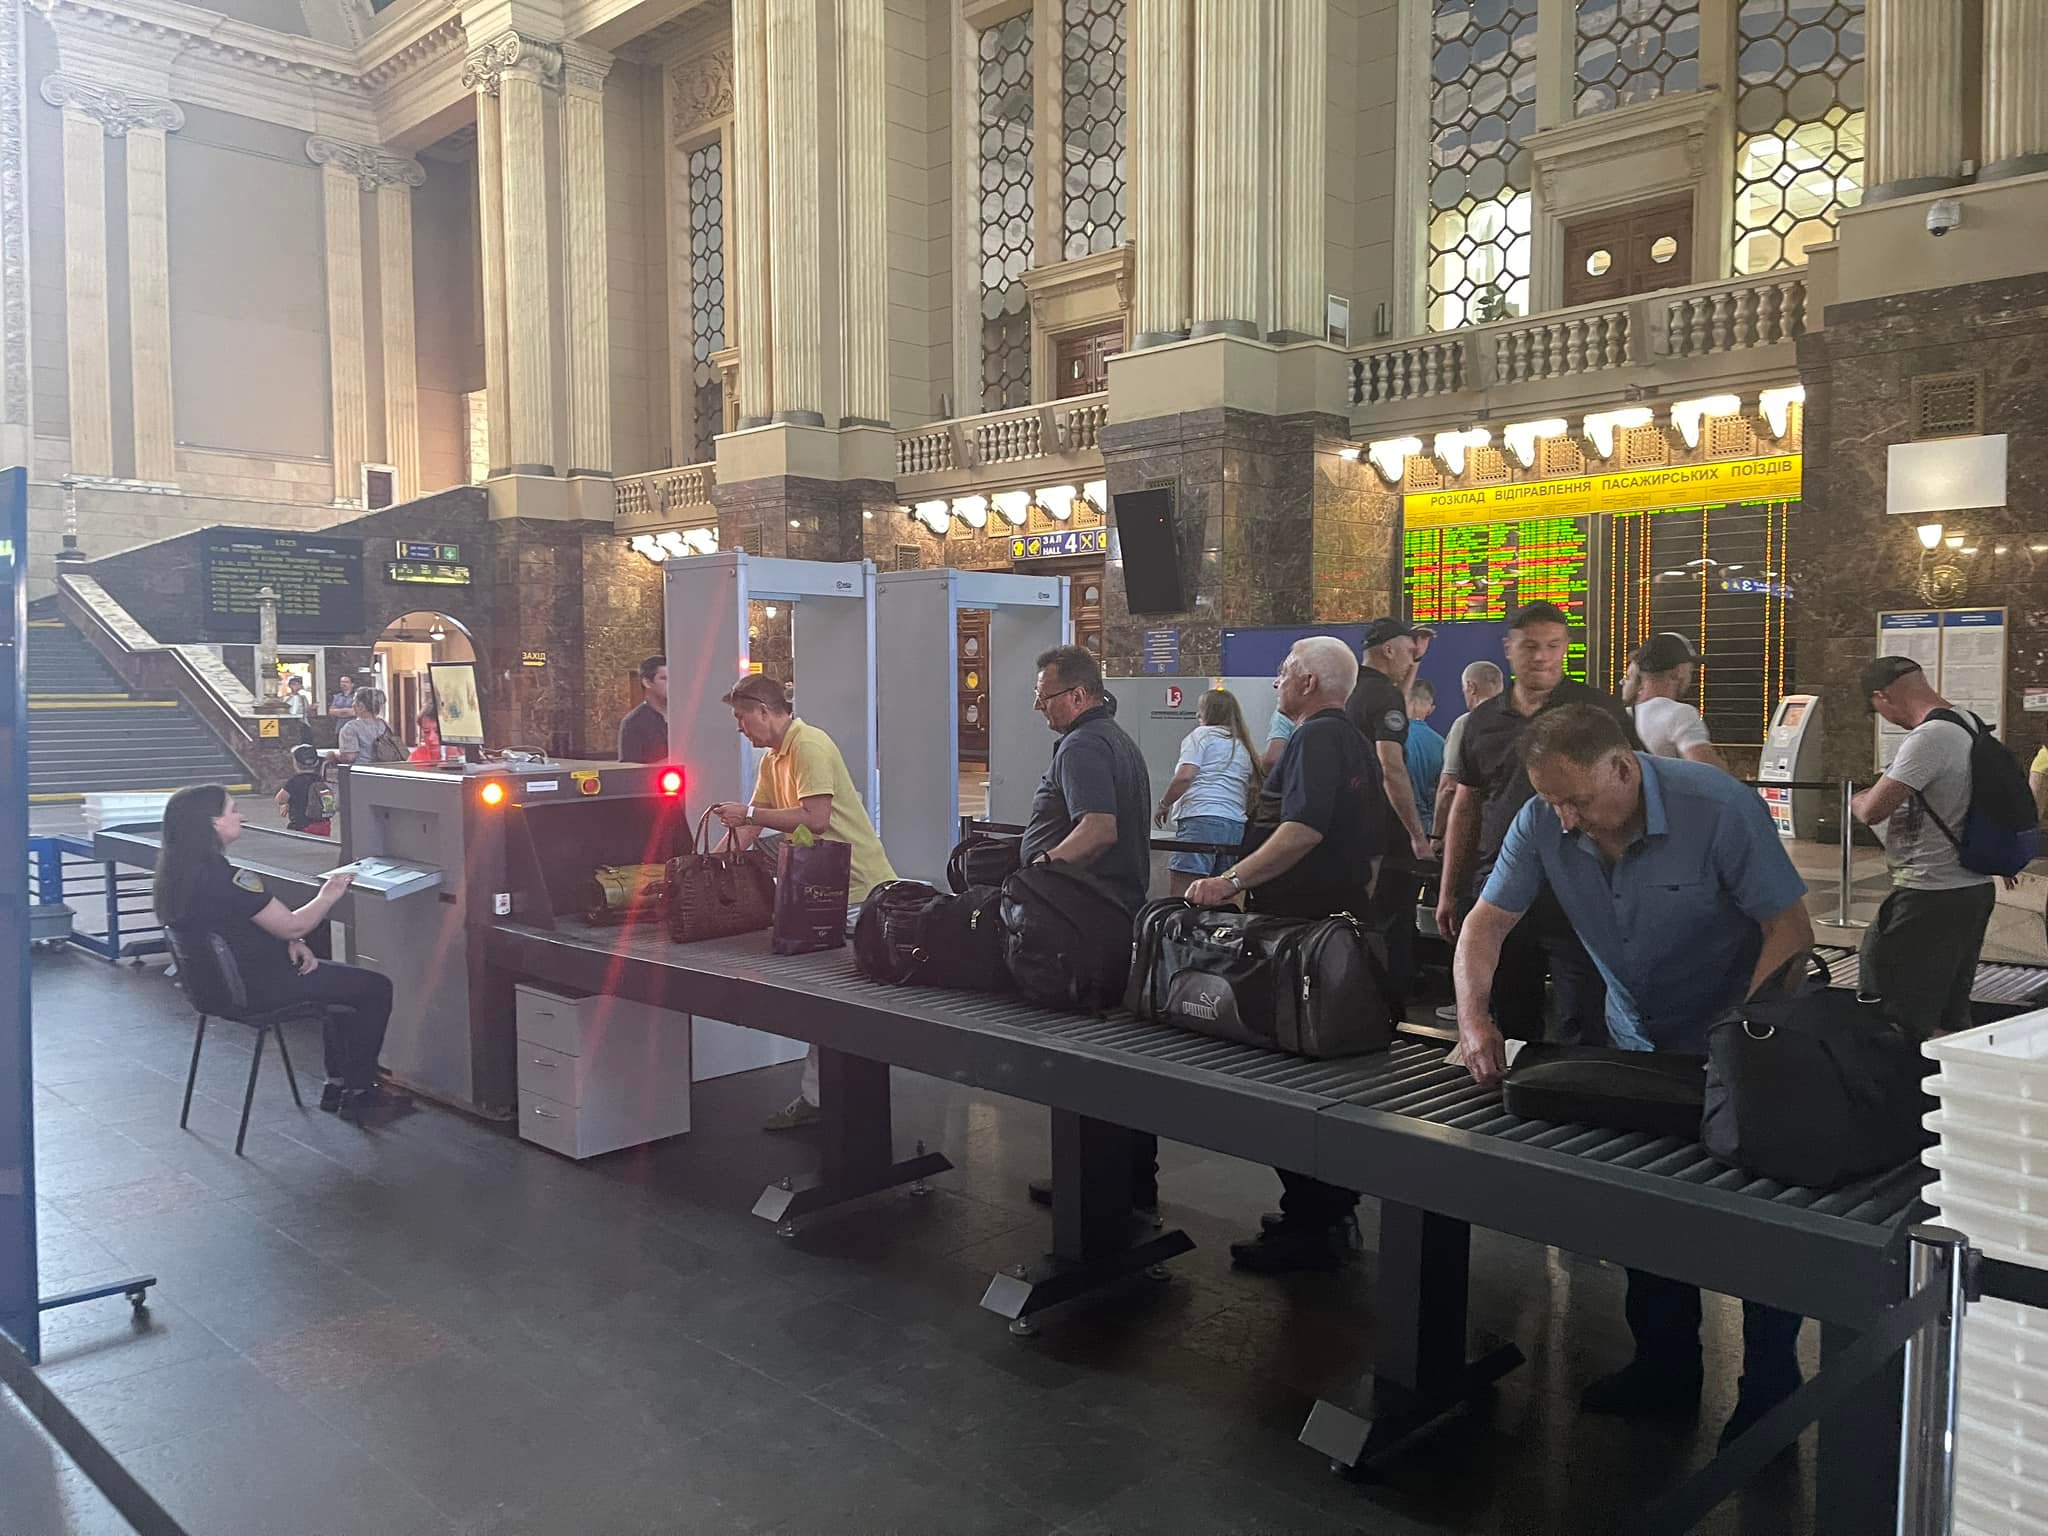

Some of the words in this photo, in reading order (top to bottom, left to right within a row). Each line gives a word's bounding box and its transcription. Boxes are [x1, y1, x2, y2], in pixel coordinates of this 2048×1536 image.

[1431, 492, 1485, 506] РОЗКЛАД
[1495, 481, 1592, 501] ВІДПРАВЛЕННЯ
[1602, 468, 1719, 490] ПАСАЖИРСЬКИХ
[1731, 460, 1792, 478] ПОЇЗДІВ
[1043, 535, 1062, 545] ЗАЛ
[1065, 533, 1077, 553] 4
[1043, 547, 1062, 556] HALL
[521, 651, 546, 661] ЗАХІД
